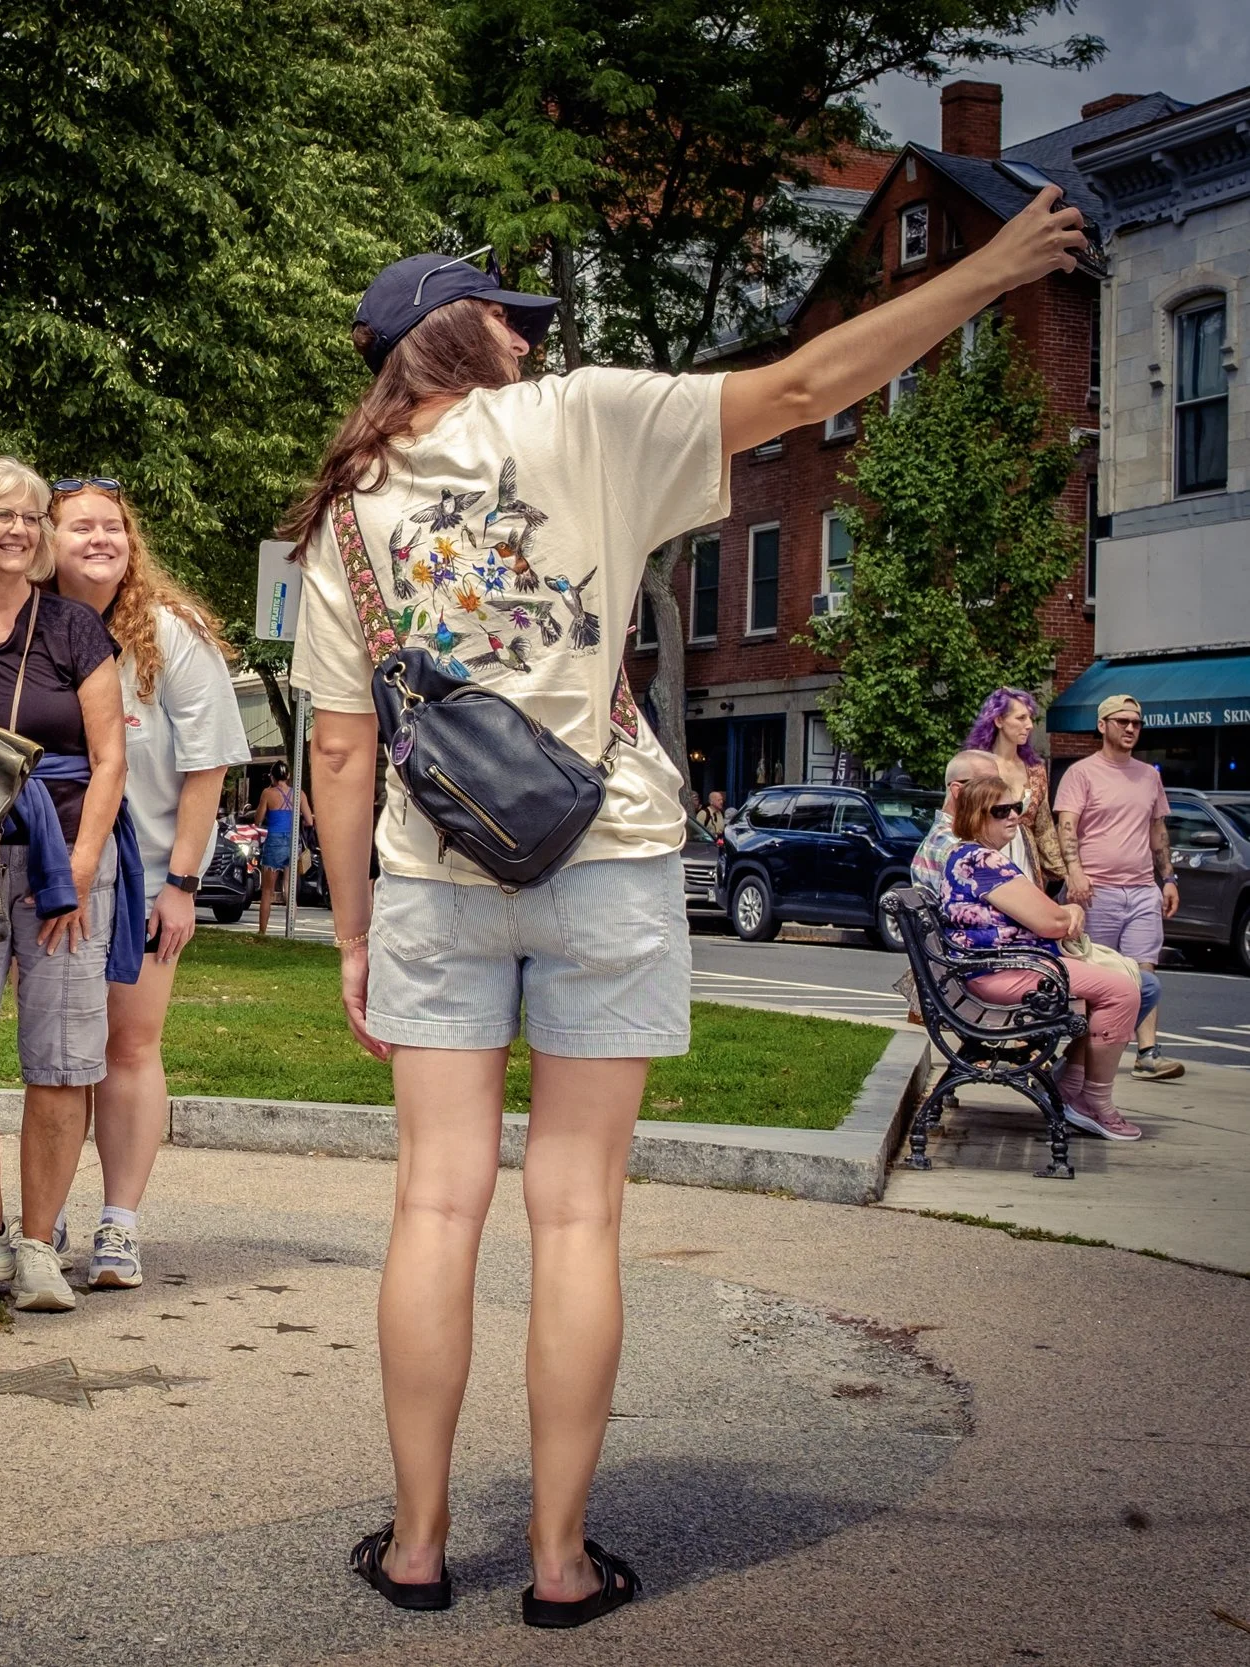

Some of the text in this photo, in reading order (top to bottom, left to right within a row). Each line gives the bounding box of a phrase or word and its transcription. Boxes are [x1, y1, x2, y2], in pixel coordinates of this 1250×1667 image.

[271, 598, 280, 621] PLASTIC
[1143, 713, 1171, 727] AURA
[1174, 711, 1212, 725] LANES
